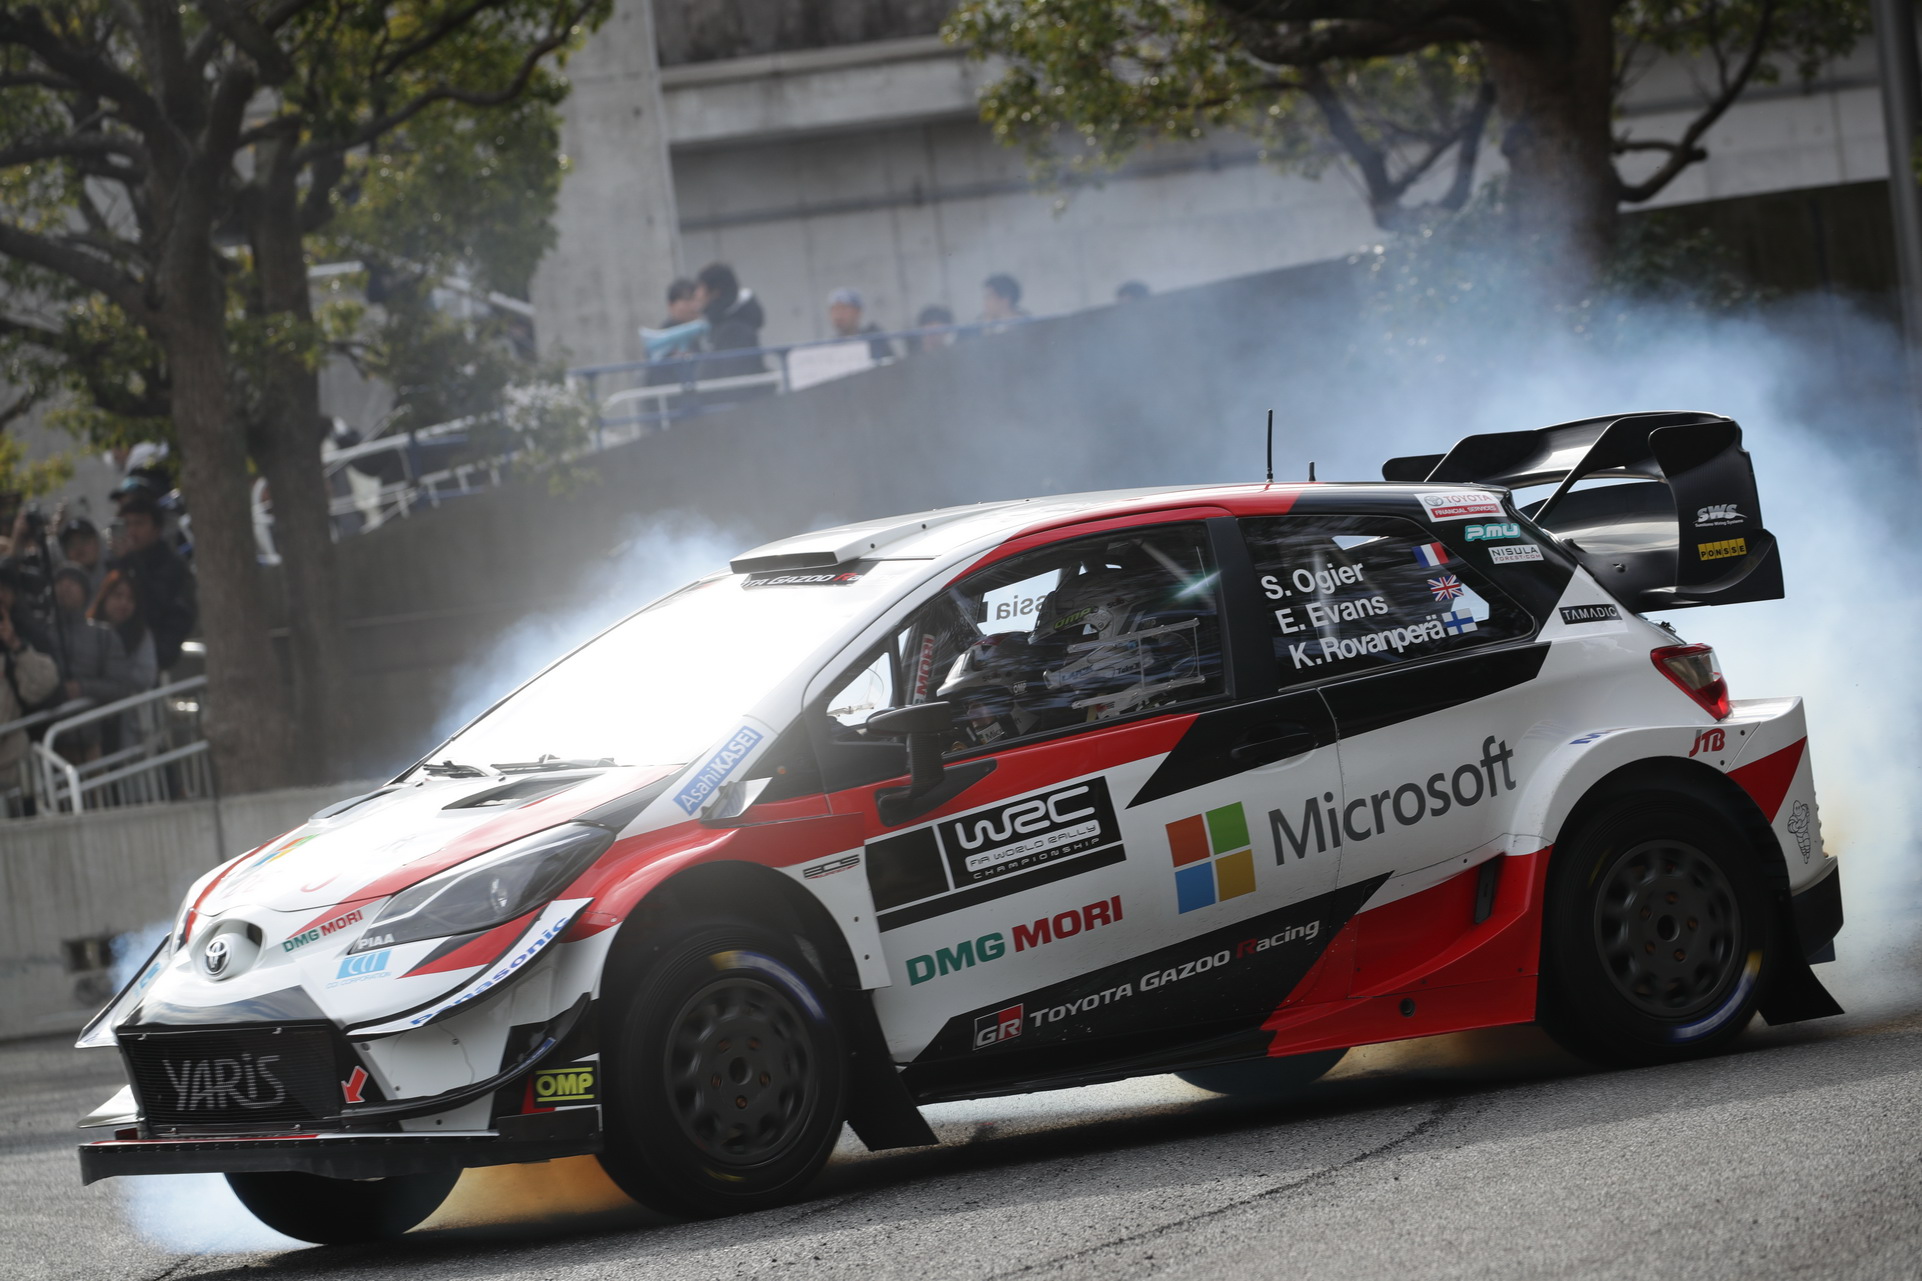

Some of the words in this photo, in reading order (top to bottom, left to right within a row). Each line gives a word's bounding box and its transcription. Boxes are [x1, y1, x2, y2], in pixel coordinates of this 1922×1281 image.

[1435, 505, 1467, 516] FINANCIAL
[1468, 504, 1497, 514] SERVICES
[1443, 493, 1493, 504] TOYOTA
[1697, 504, 1738, 522] SWS
[1491, 546, 1539, 556] NISULA
[1701, 545, 1745, 558] PONSSE
[767, 574, 836, 585] GAZOO
[1261, 575, 1292, 600] S.
[1292, 562, 1364, 595] Ogier
[1275, 608, 1306, 635] E.
[1305, 595, 1389, 628] Evans
[1562, 606, 1619, 622] TAMADIC
[1288, 641, 1323, 670] K.
[1320, 614, 1446, 663] Rovanperä
[1689, 728, 1726, 757] JTB
[681, 729, 758, 811] AsahiKASEI
[955, 785, 1096, 850] WRC
[1268, 735, 1516, 866] Microsoft
[970, 854, 991, 867] FIA
[994, 840, 1045, 861] WORLD
[1049, 823, 1098, 844] RALLY
[973, 836, 1101, 880] CHAMPIONSHIP
[282, 929, 320, 953] DMG
[320, 909, 364, 937] MORI
[358, 933, 396, 949] PIAA
[905, 932, 1006, 986] DMG
[1011, 895, 1123, 953] MORI
[1029, 983, 1133, 1028] TOYOTA
[1140, 950, 1230, 992] GAZOO
[1236, 920, 1320, 959] Racing
[976, 1018, 1021, 1048] GR
[536, 1073, 594, 1096] OMP
